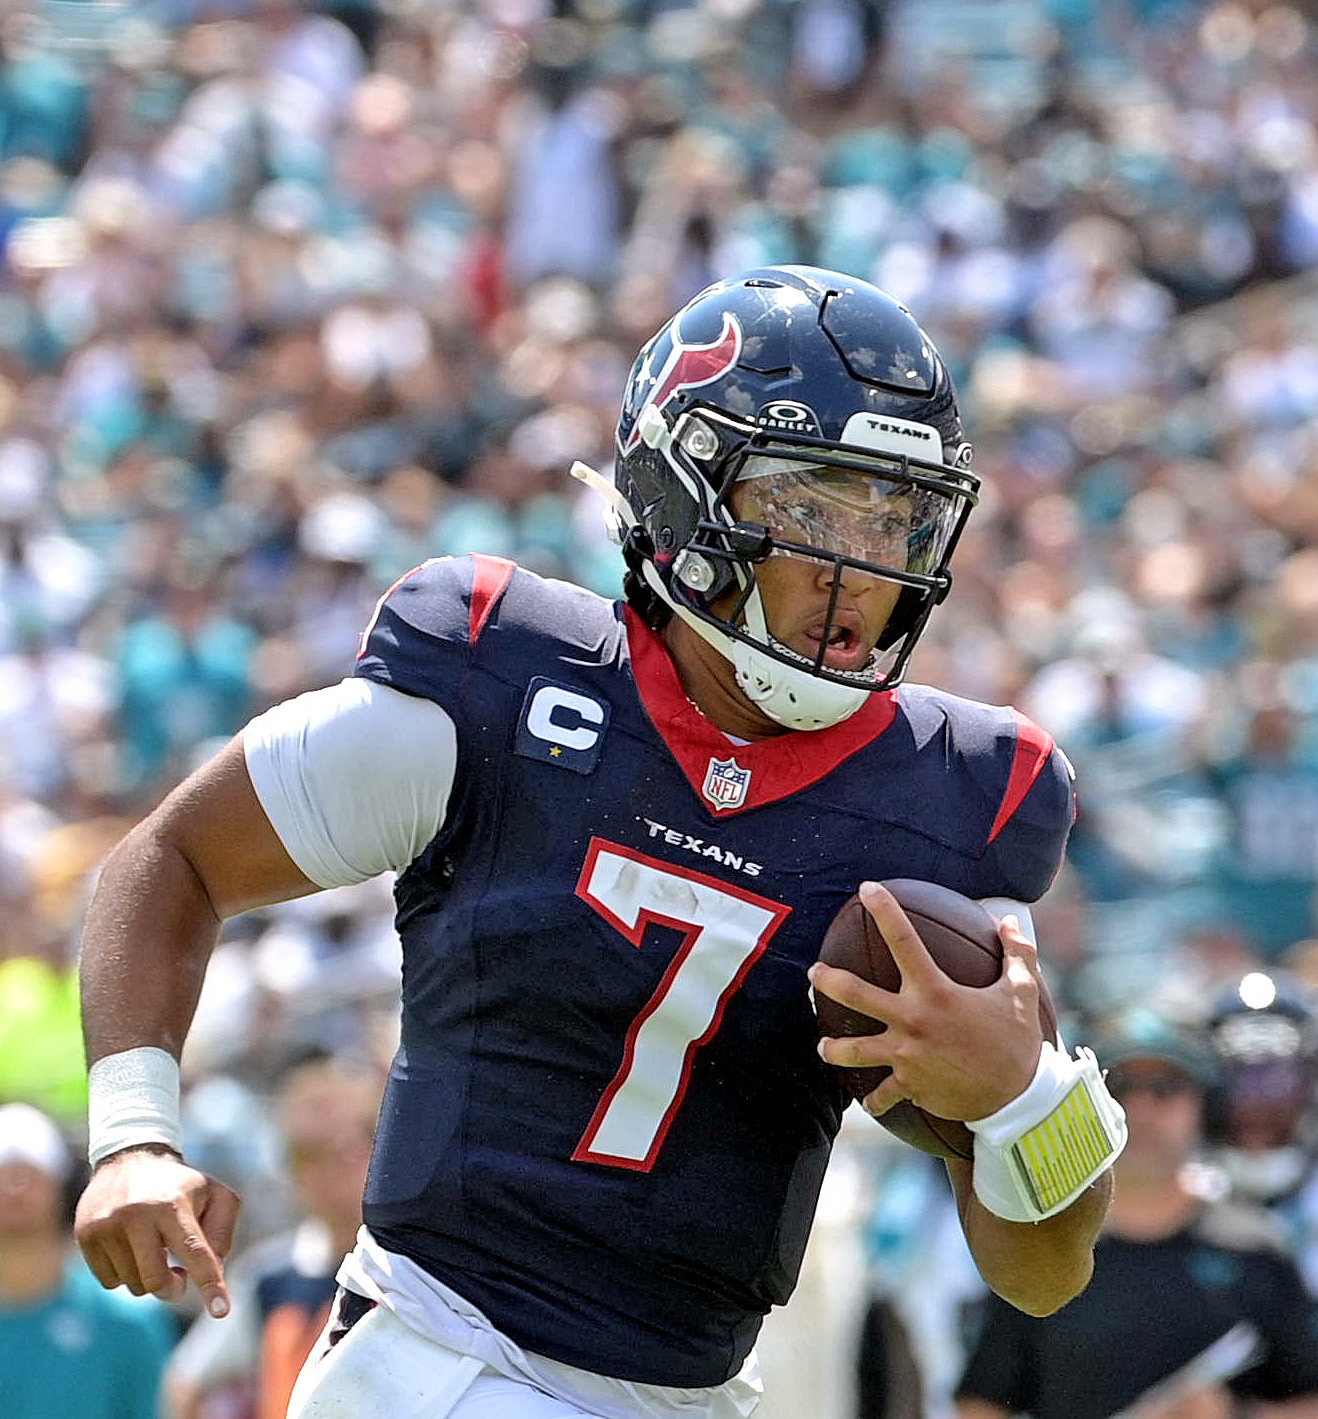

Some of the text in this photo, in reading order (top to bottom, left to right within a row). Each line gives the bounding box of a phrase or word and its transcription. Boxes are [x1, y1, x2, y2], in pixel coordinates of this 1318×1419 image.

[758, 417, 817, 432] OAKLEY
[867, 420, 930, 440] TEXANS
[526, 686, 604, 750] C
[710, 776, 738, 801] NFL
[643, 817, 763, 877] TEXANS
[570, 836, 793, 1174] 7
